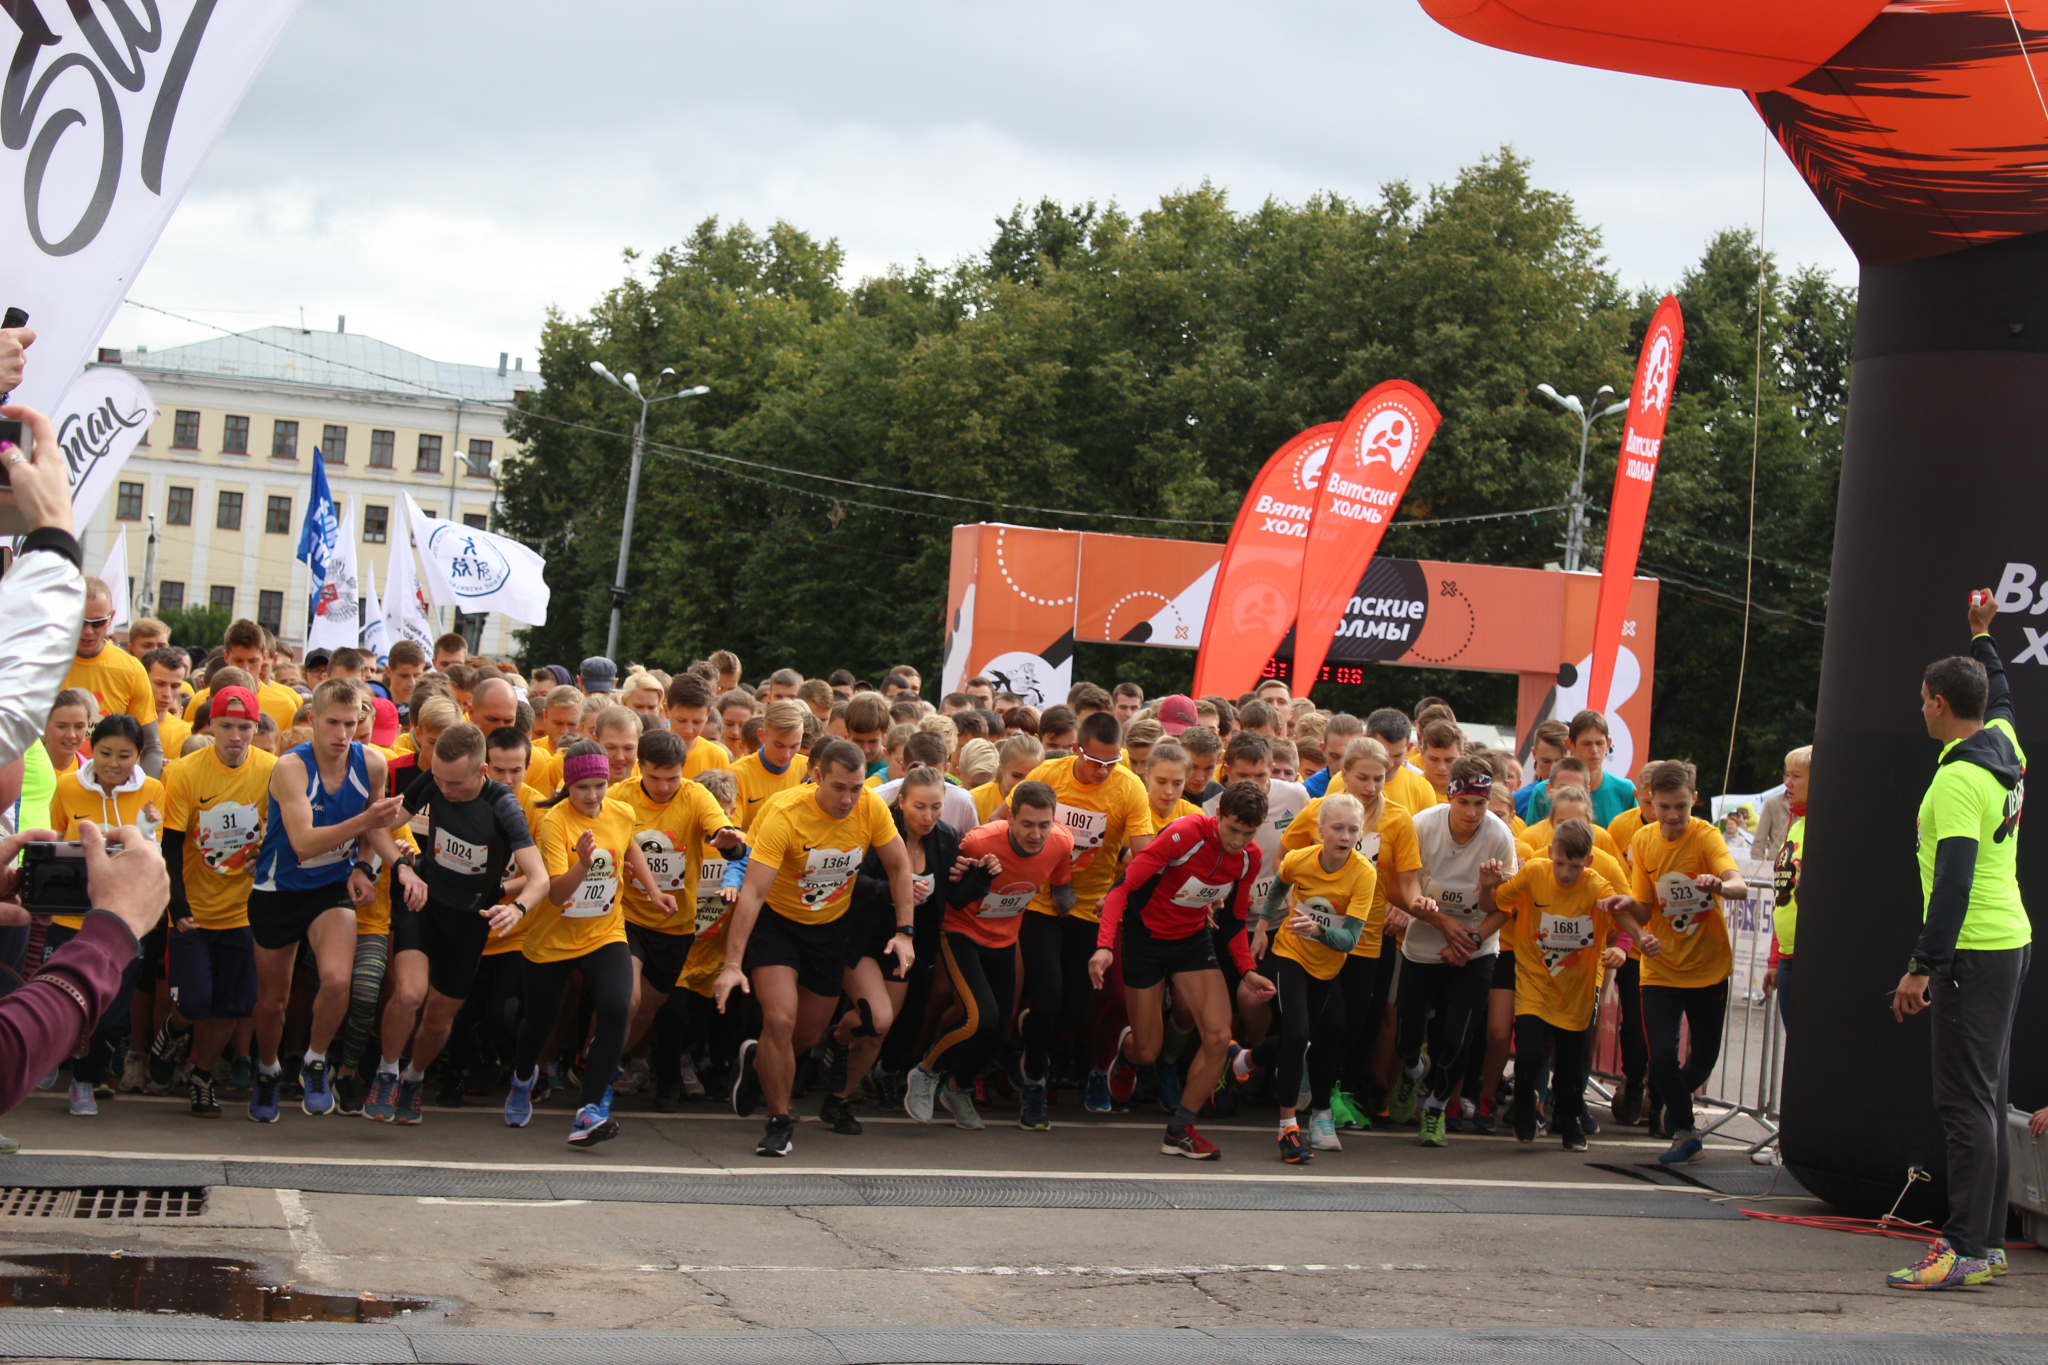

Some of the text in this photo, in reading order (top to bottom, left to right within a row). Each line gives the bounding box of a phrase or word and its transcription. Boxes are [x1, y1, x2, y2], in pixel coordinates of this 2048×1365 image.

[1626, 427, 1660, 458] Вятские
[1625, 458, 1655, 482] холмы
[1327, 472, 1398, 506] Вятские
[1255, 495, 1313, 522] Вятс
[1260, 517, 1309, 538] хол
[1344, 595, 1425, 620] тские
[1334, 618, 1411, 642] олмы
[222, 813, 237, 830] 31
[1065, 811, 1093, 830] 1097
[446, 839, 472, 861] 1024
[646, 857, 669, 873] 585
[821, 855, 851, 869] 1364
[700, 864, 722, 880] 077
[584, 884, 605, 900] 702
[1197, 887, 1220, 898] 950
[1256, 882, 1273, 897] 12
[1442, 890, 1463, 903] 605
[1670, 886, 1693, 900] 523
[1000, 897, 1022, 907] 997
[696, 914, 718, 922] лмы
[697, 906, 724, 915] ские
[1553, 920, 1580, 934] 1681
